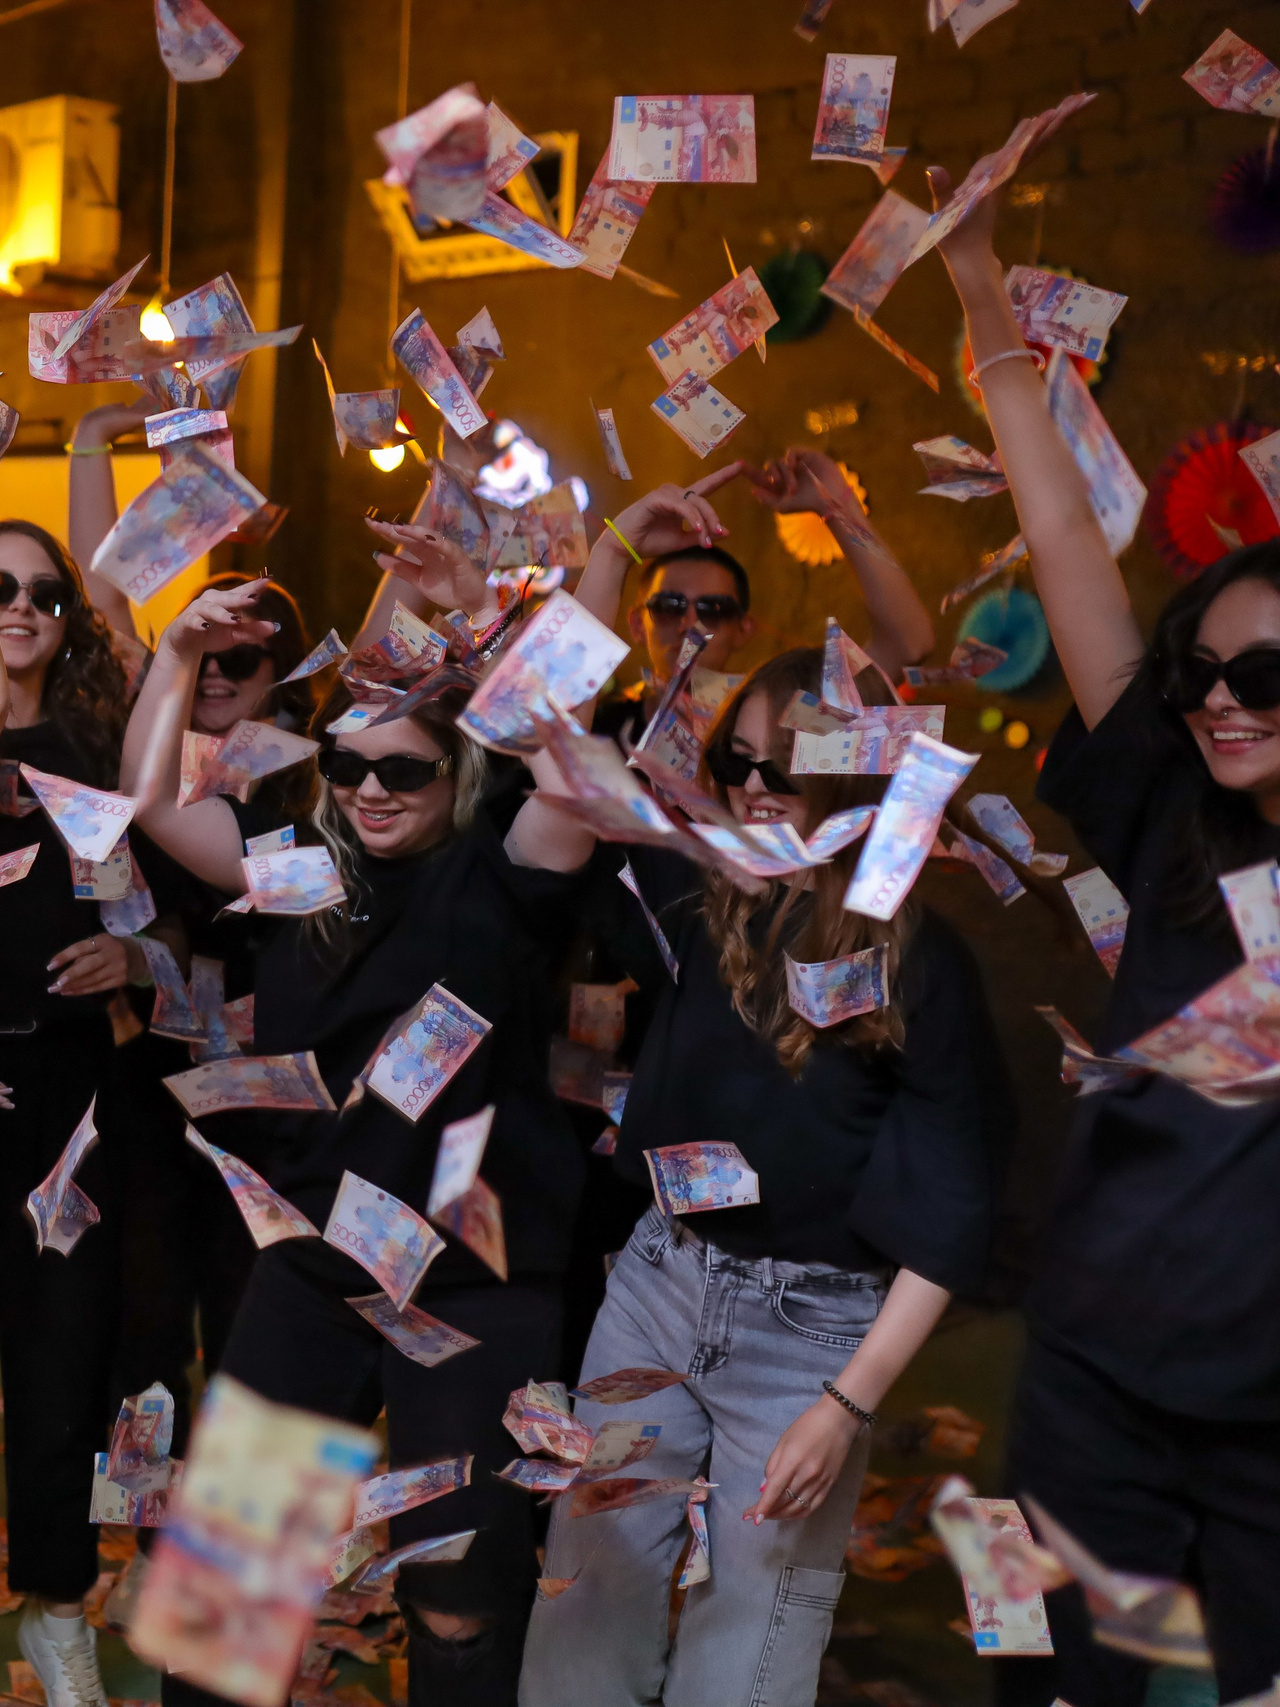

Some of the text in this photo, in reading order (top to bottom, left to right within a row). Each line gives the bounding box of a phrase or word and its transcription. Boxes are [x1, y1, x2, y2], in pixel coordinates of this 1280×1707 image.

[831, 57, 846, 91] 5000
[540, 234, 580, 262] 5000
[52, 312, 73, 322] 5000
[452, 396, 477, 431] 5000
[126, 561, 164, 595] 5000
[541, 602, 575, 641] 5000
[237, 725, 261, 751] 5000
[92, 799, 132, 818] 5000
[869, 868, 903, 910] 5000
[401, 1080, 430, 1112] 5000
[330, 1221, 365, 1249] 5000
[355, 1505, 386, 1522] 5000
